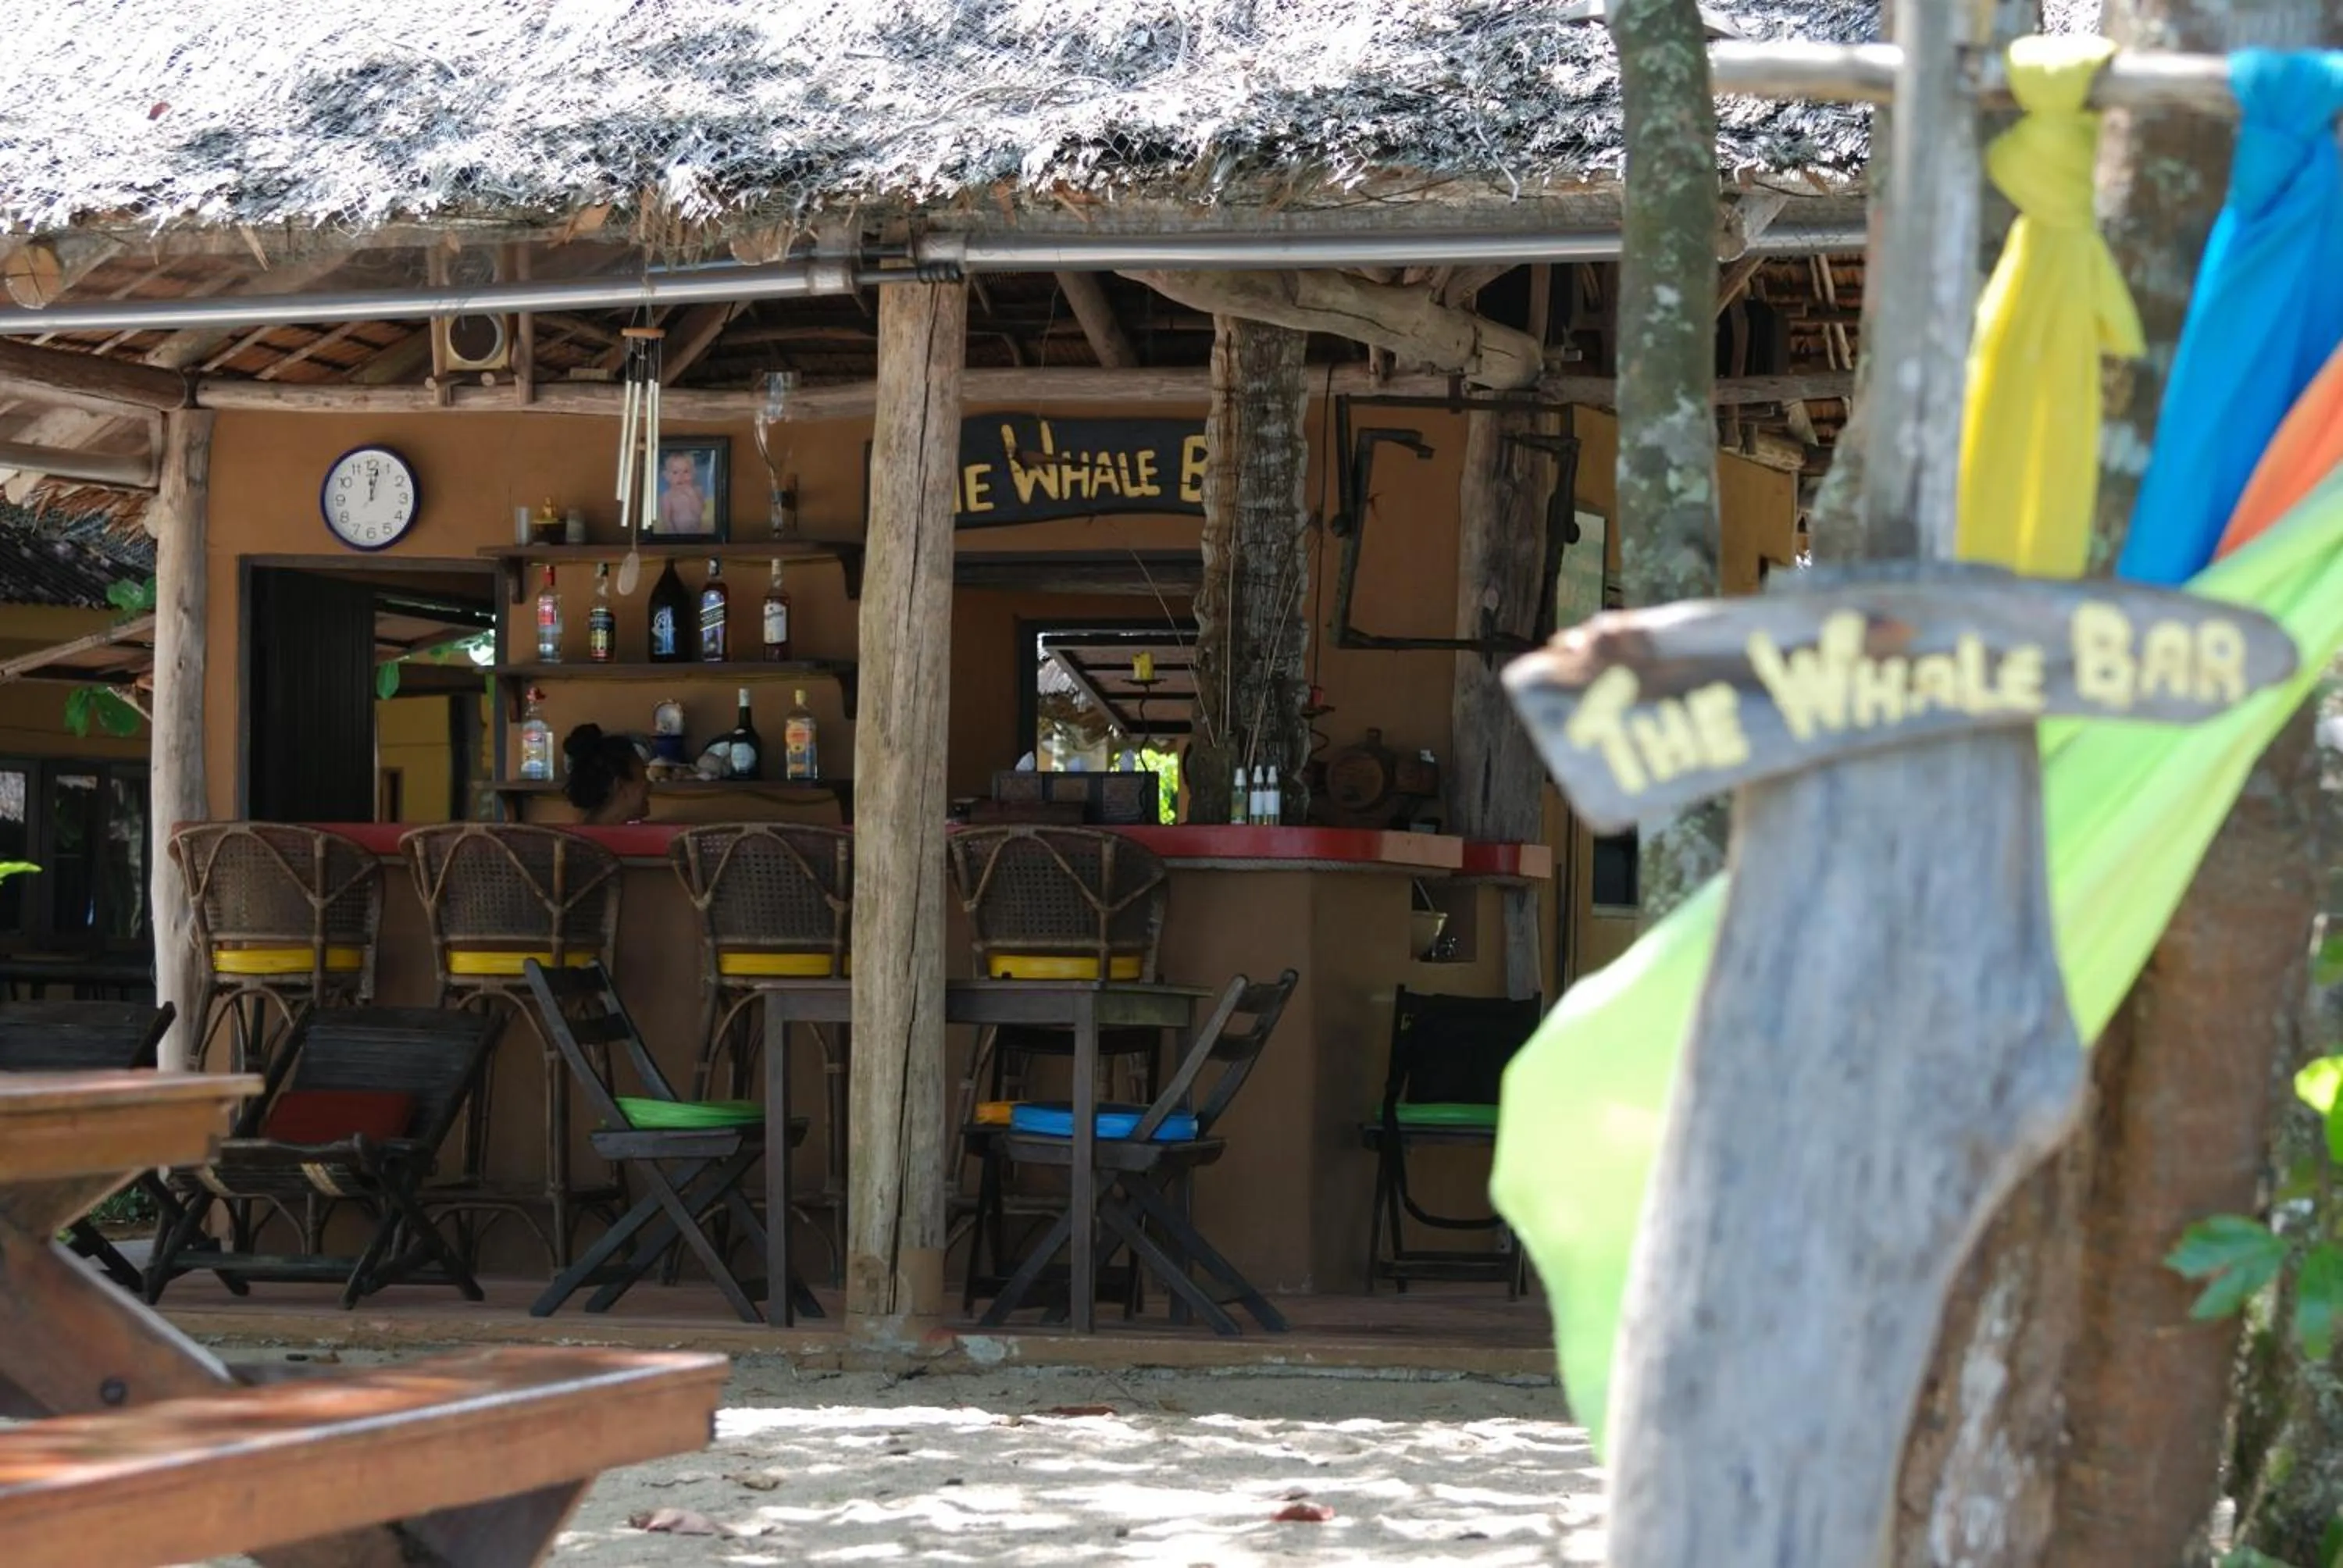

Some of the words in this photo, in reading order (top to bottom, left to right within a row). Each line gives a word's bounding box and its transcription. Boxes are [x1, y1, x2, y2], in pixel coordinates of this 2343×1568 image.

[366, 458, 380, 471] 12
[384, 462, 390, 475] 1
[1001, 420, 1161, 504] WHALE
[351, 463, 361, 476] 11
[338, 476, 353, 489] 10
[394, 474, 405, 487] 2
[335, 494, 346, 507] 9
[398, 492, 408, 505] 3
[340, 511, 350, 524] 8
[394, 510, 403, 521] 4
[352, 523, 361, 536] 7
[366, 527, 377, 540] 6
[382, 522, 393, 535] 5
[1565, 665, 1749, 795] THE
[1746, 608, 2044, 742] WHALE
[2070, 600, 2248, 711] BAR
